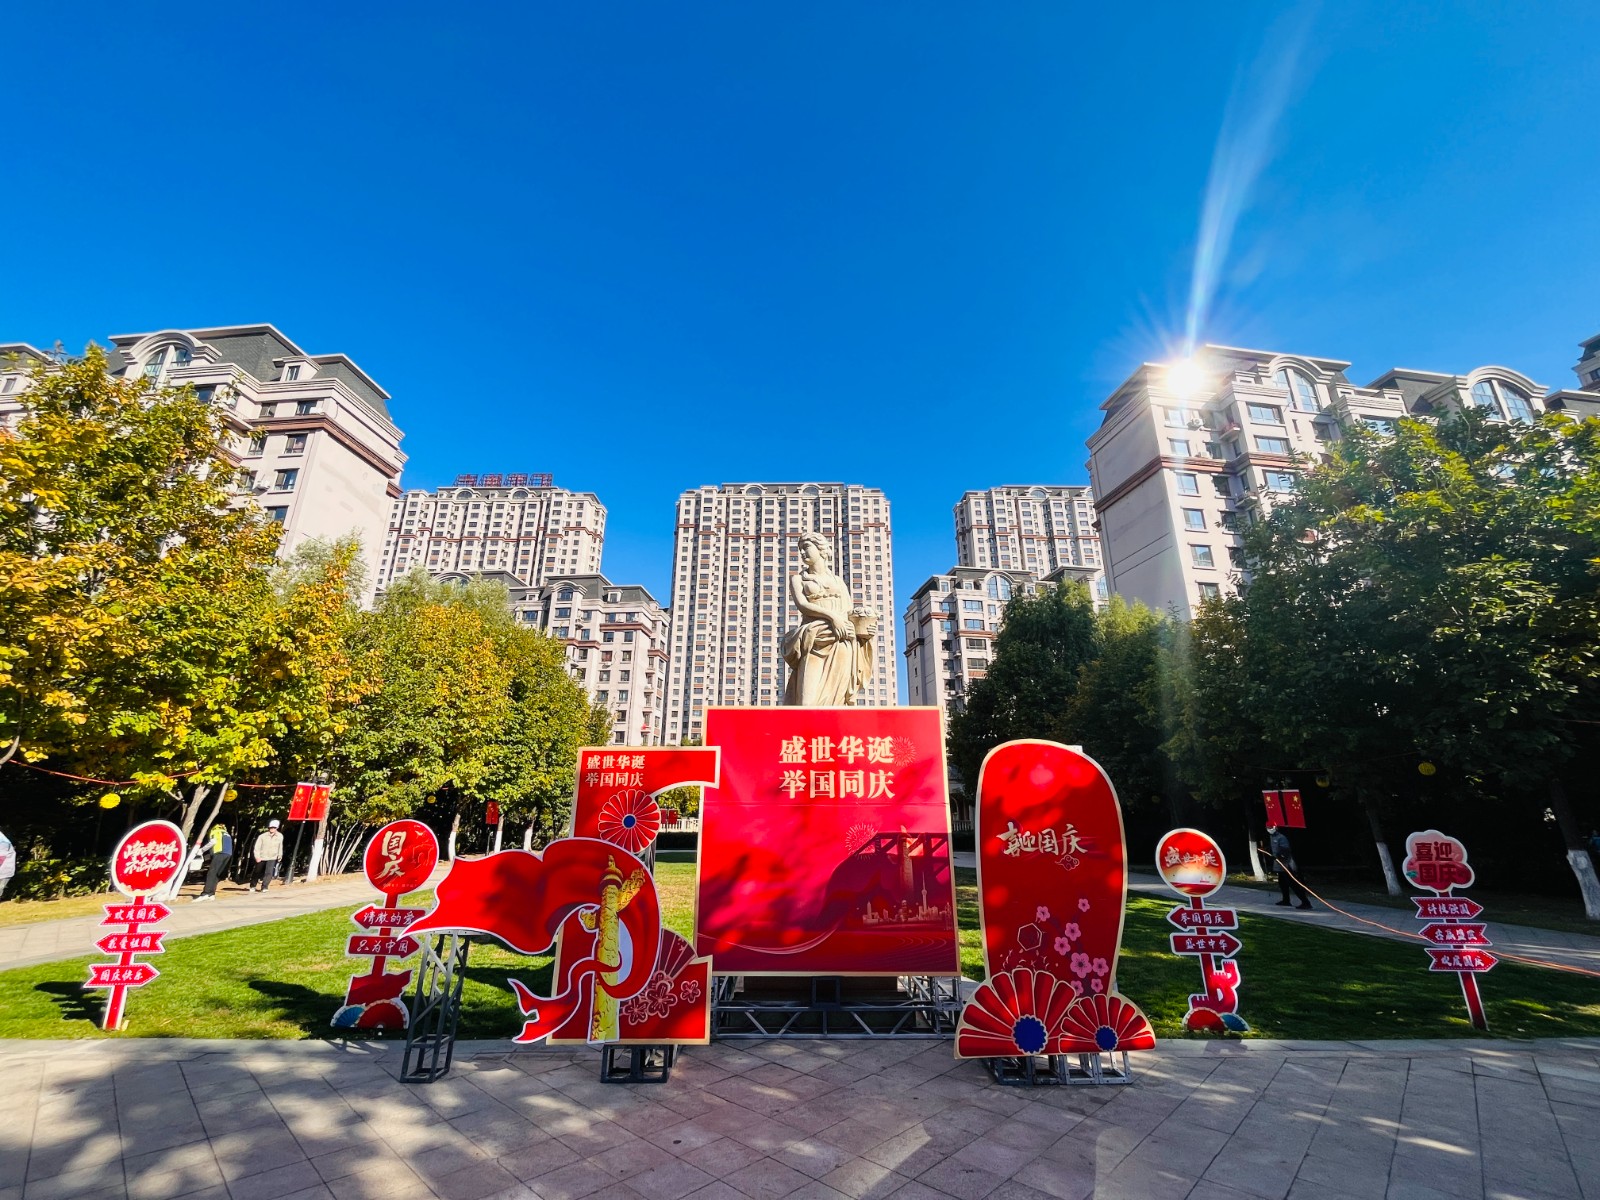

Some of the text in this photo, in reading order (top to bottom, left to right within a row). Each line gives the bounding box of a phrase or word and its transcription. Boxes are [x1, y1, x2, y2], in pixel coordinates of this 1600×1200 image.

[779, 735, 895, 764] 盛世华诞
[586, 755, 646, 770] 盛世华诞
[584, 772, 645, 788] 举国同庆
[778, 769, 896, 799] 举国同庆
[996, 821, 1088, 858] 喜迎国庆
[374, 831, 408, 880] 国庆
[1164, 846, 1219, 867] 盛世华诞
[1415, 841, 1453, 861] 喜迎
[1418, 863, 1457, 883] 国庆
[114, 907, 157, 920] 欢度国庆
[1180, 912, 1225, 925] 举国同庆
[107, 936, 151, 950] 我爱祖国
[356, 939, 409, 954] 只为中国
[1185, 938, 1228, 951] 盛世中华
[100, 968, 144, 982] 国庆快乐
